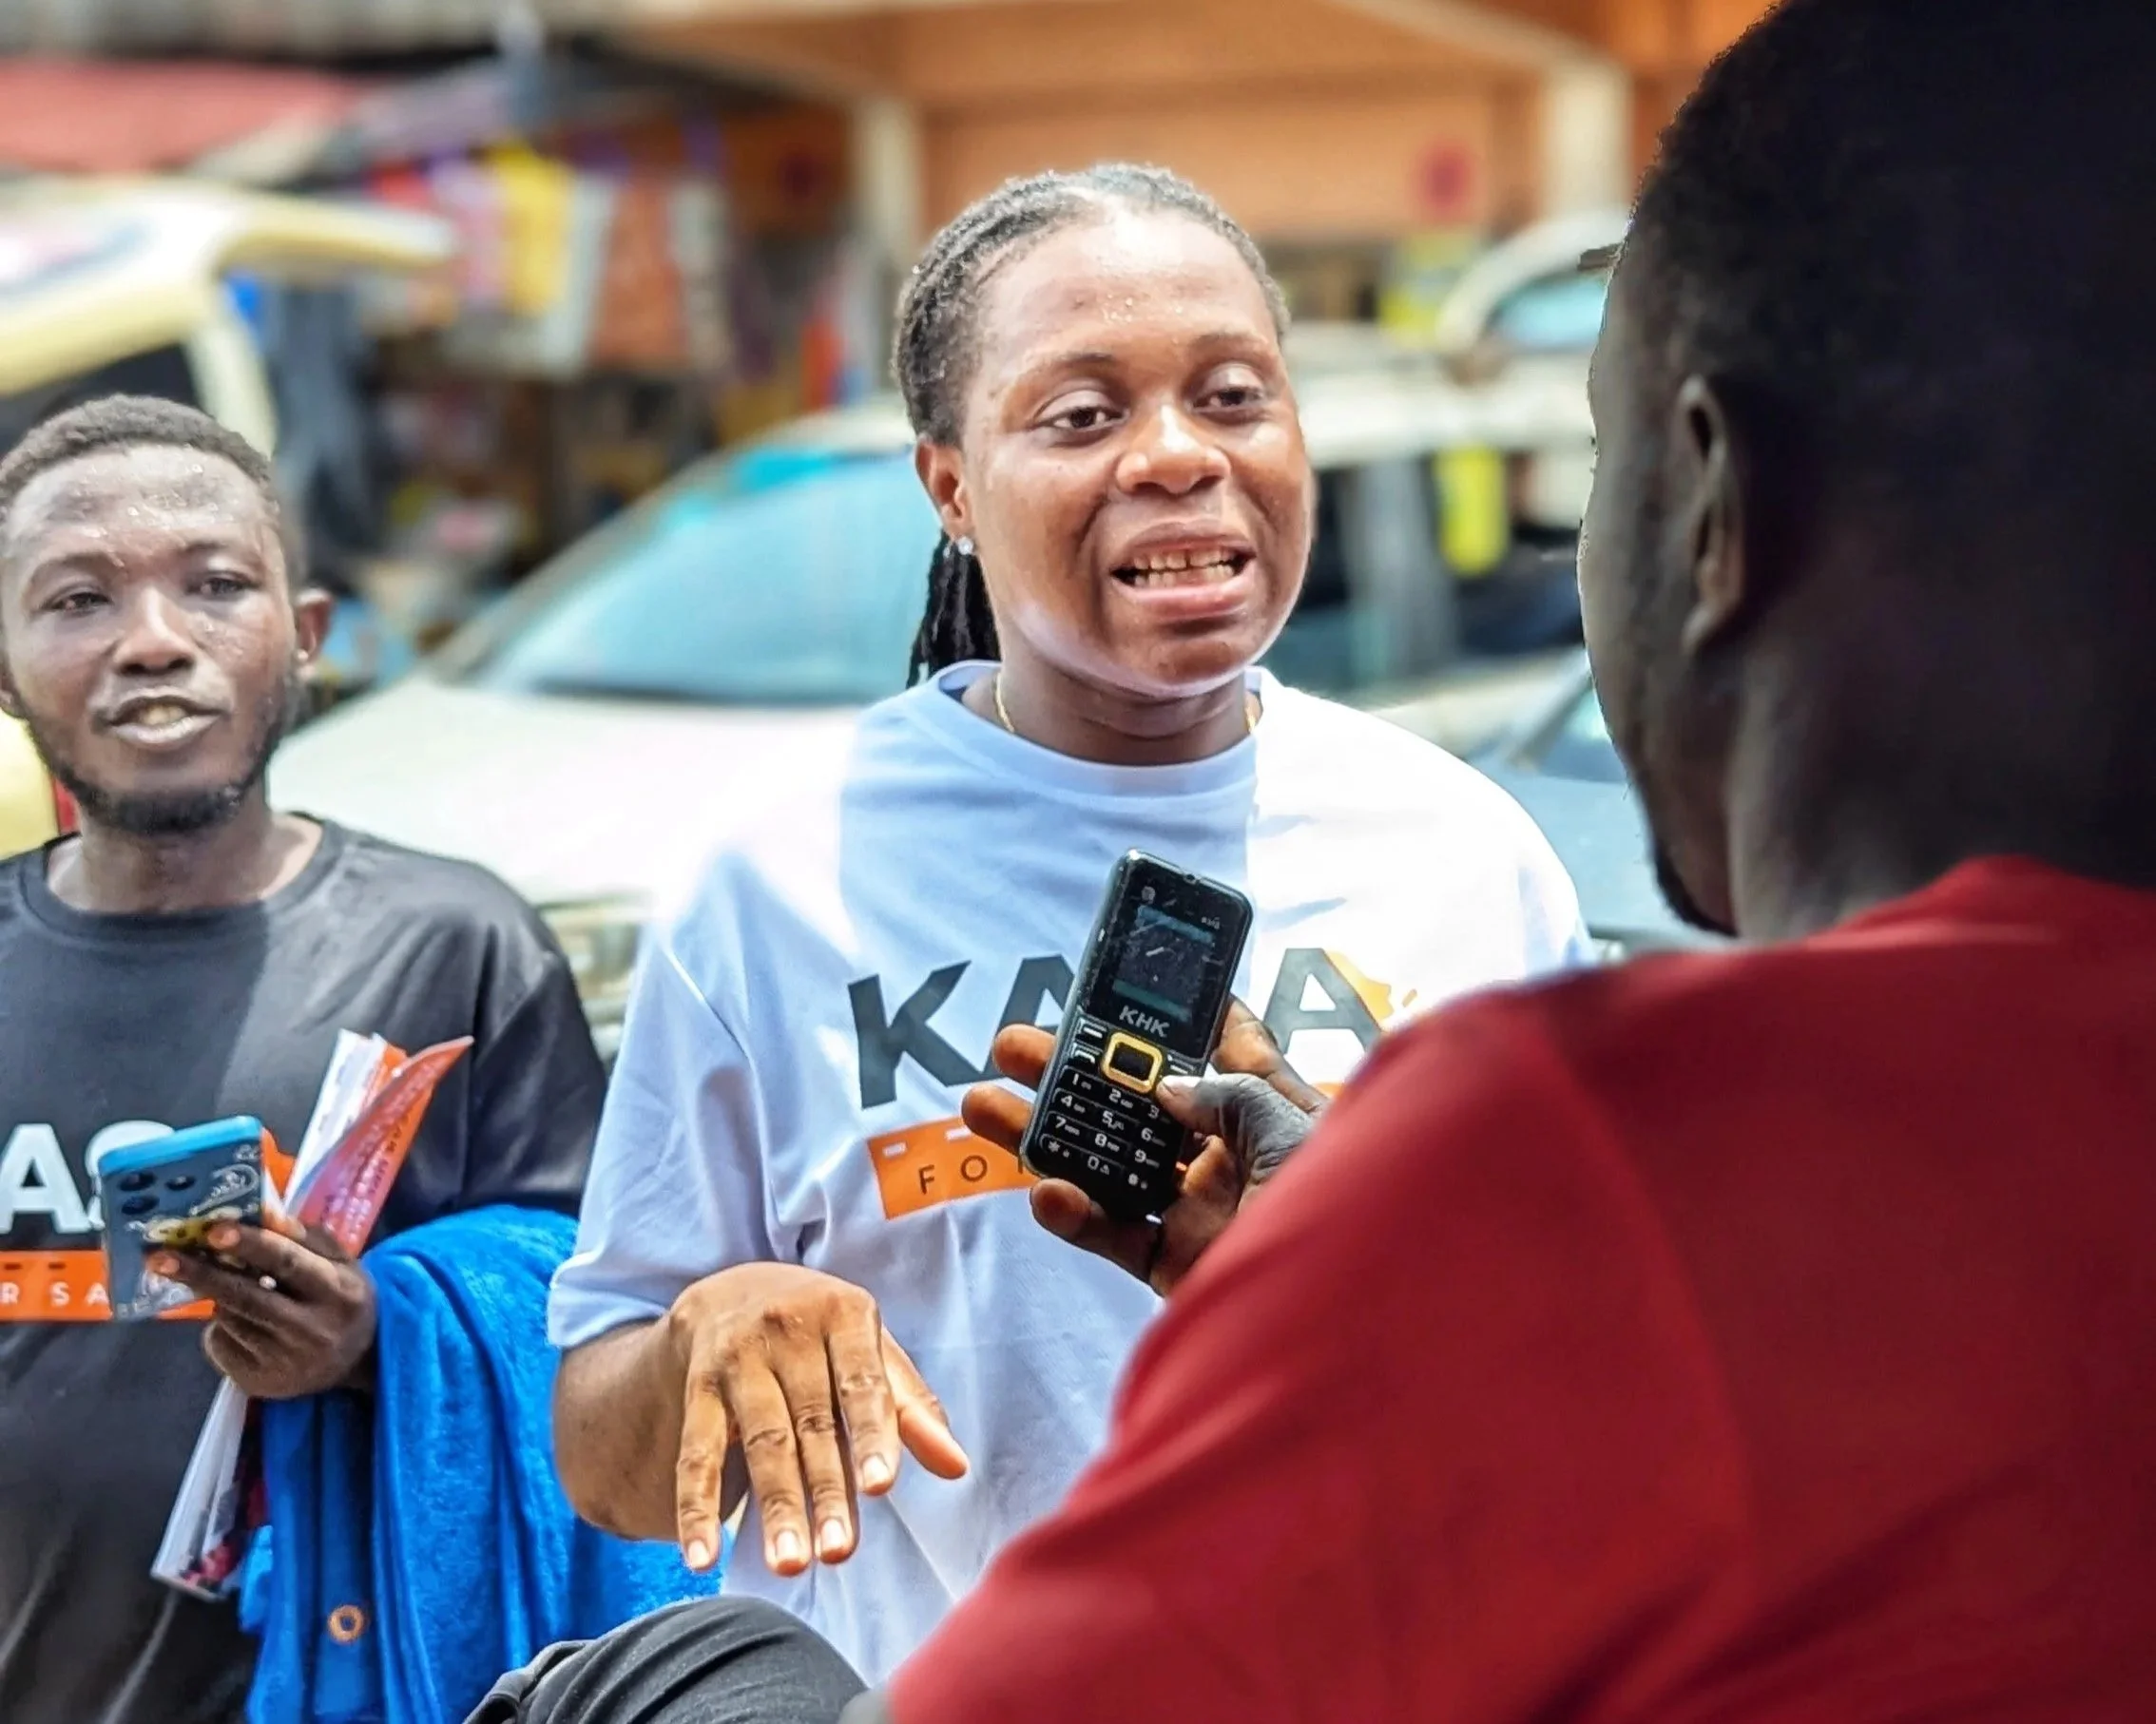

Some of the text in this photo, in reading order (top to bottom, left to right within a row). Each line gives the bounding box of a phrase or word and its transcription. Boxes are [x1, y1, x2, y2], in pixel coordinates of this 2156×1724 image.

[1119, 1006, 1170, 1037] KHK
[1061, 1095, 1153, 1141] 4 5 6
[1108, 1088, 1122, 1102] 2
[1148, 1104, 1160, 1120] 3
[1055, 1116, 1066, 1128] 7
[1094, 1133, 1107, 1147] 8
[1134, 1149, 1146, 1163] 9
[918, 1155, 1024, 1195] FO
